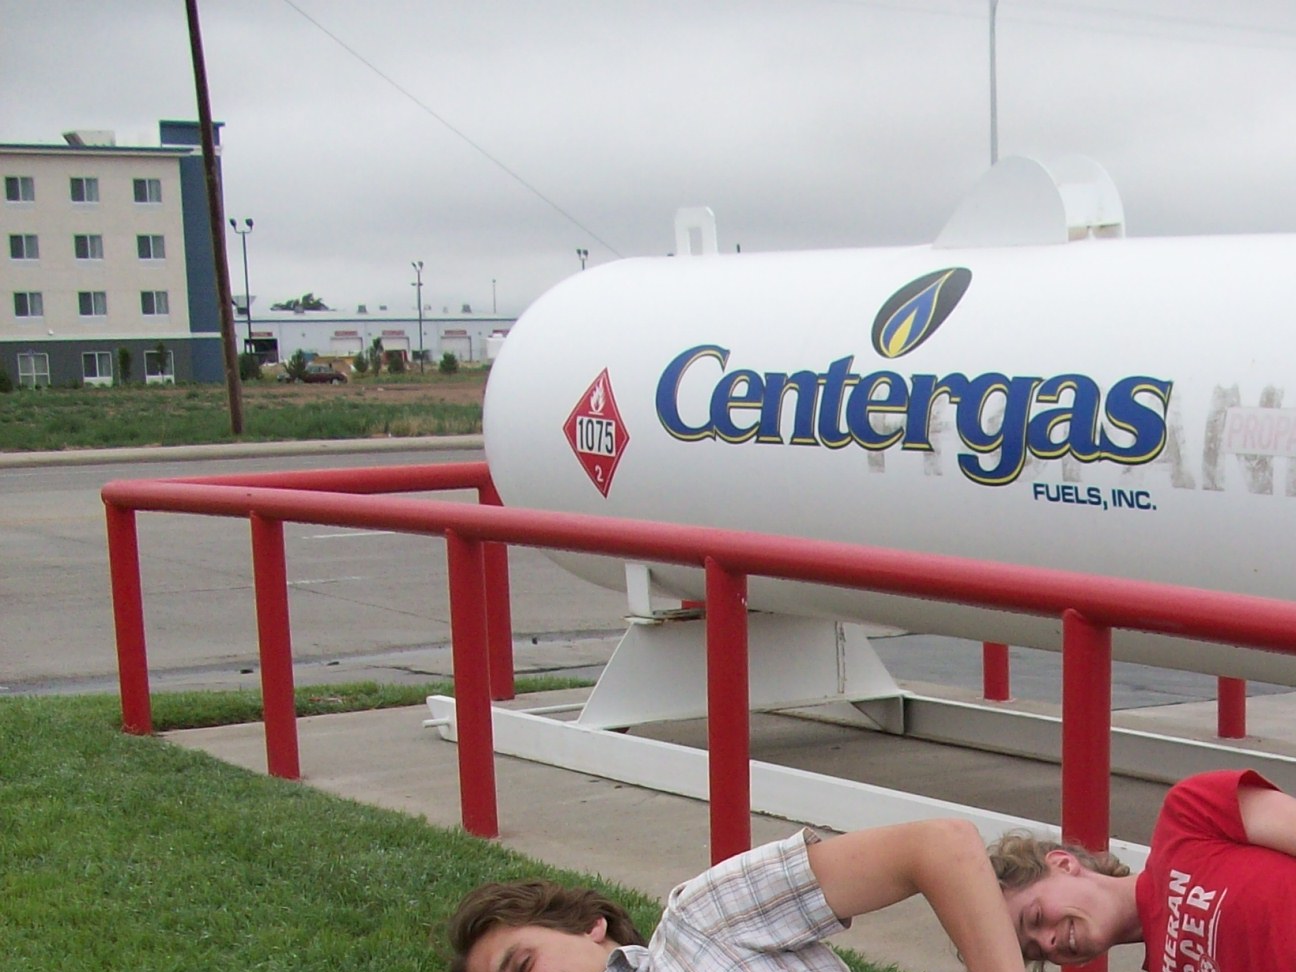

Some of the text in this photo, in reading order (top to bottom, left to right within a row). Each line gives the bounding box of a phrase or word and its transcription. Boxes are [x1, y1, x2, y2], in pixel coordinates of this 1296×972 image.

[655, 344, 1174, 486] Centergas
[578, 417, 614, 455] 1075
[595, 465, 603, 482] 2
[1033, 483, 1157, 510] FUELS, INC.
